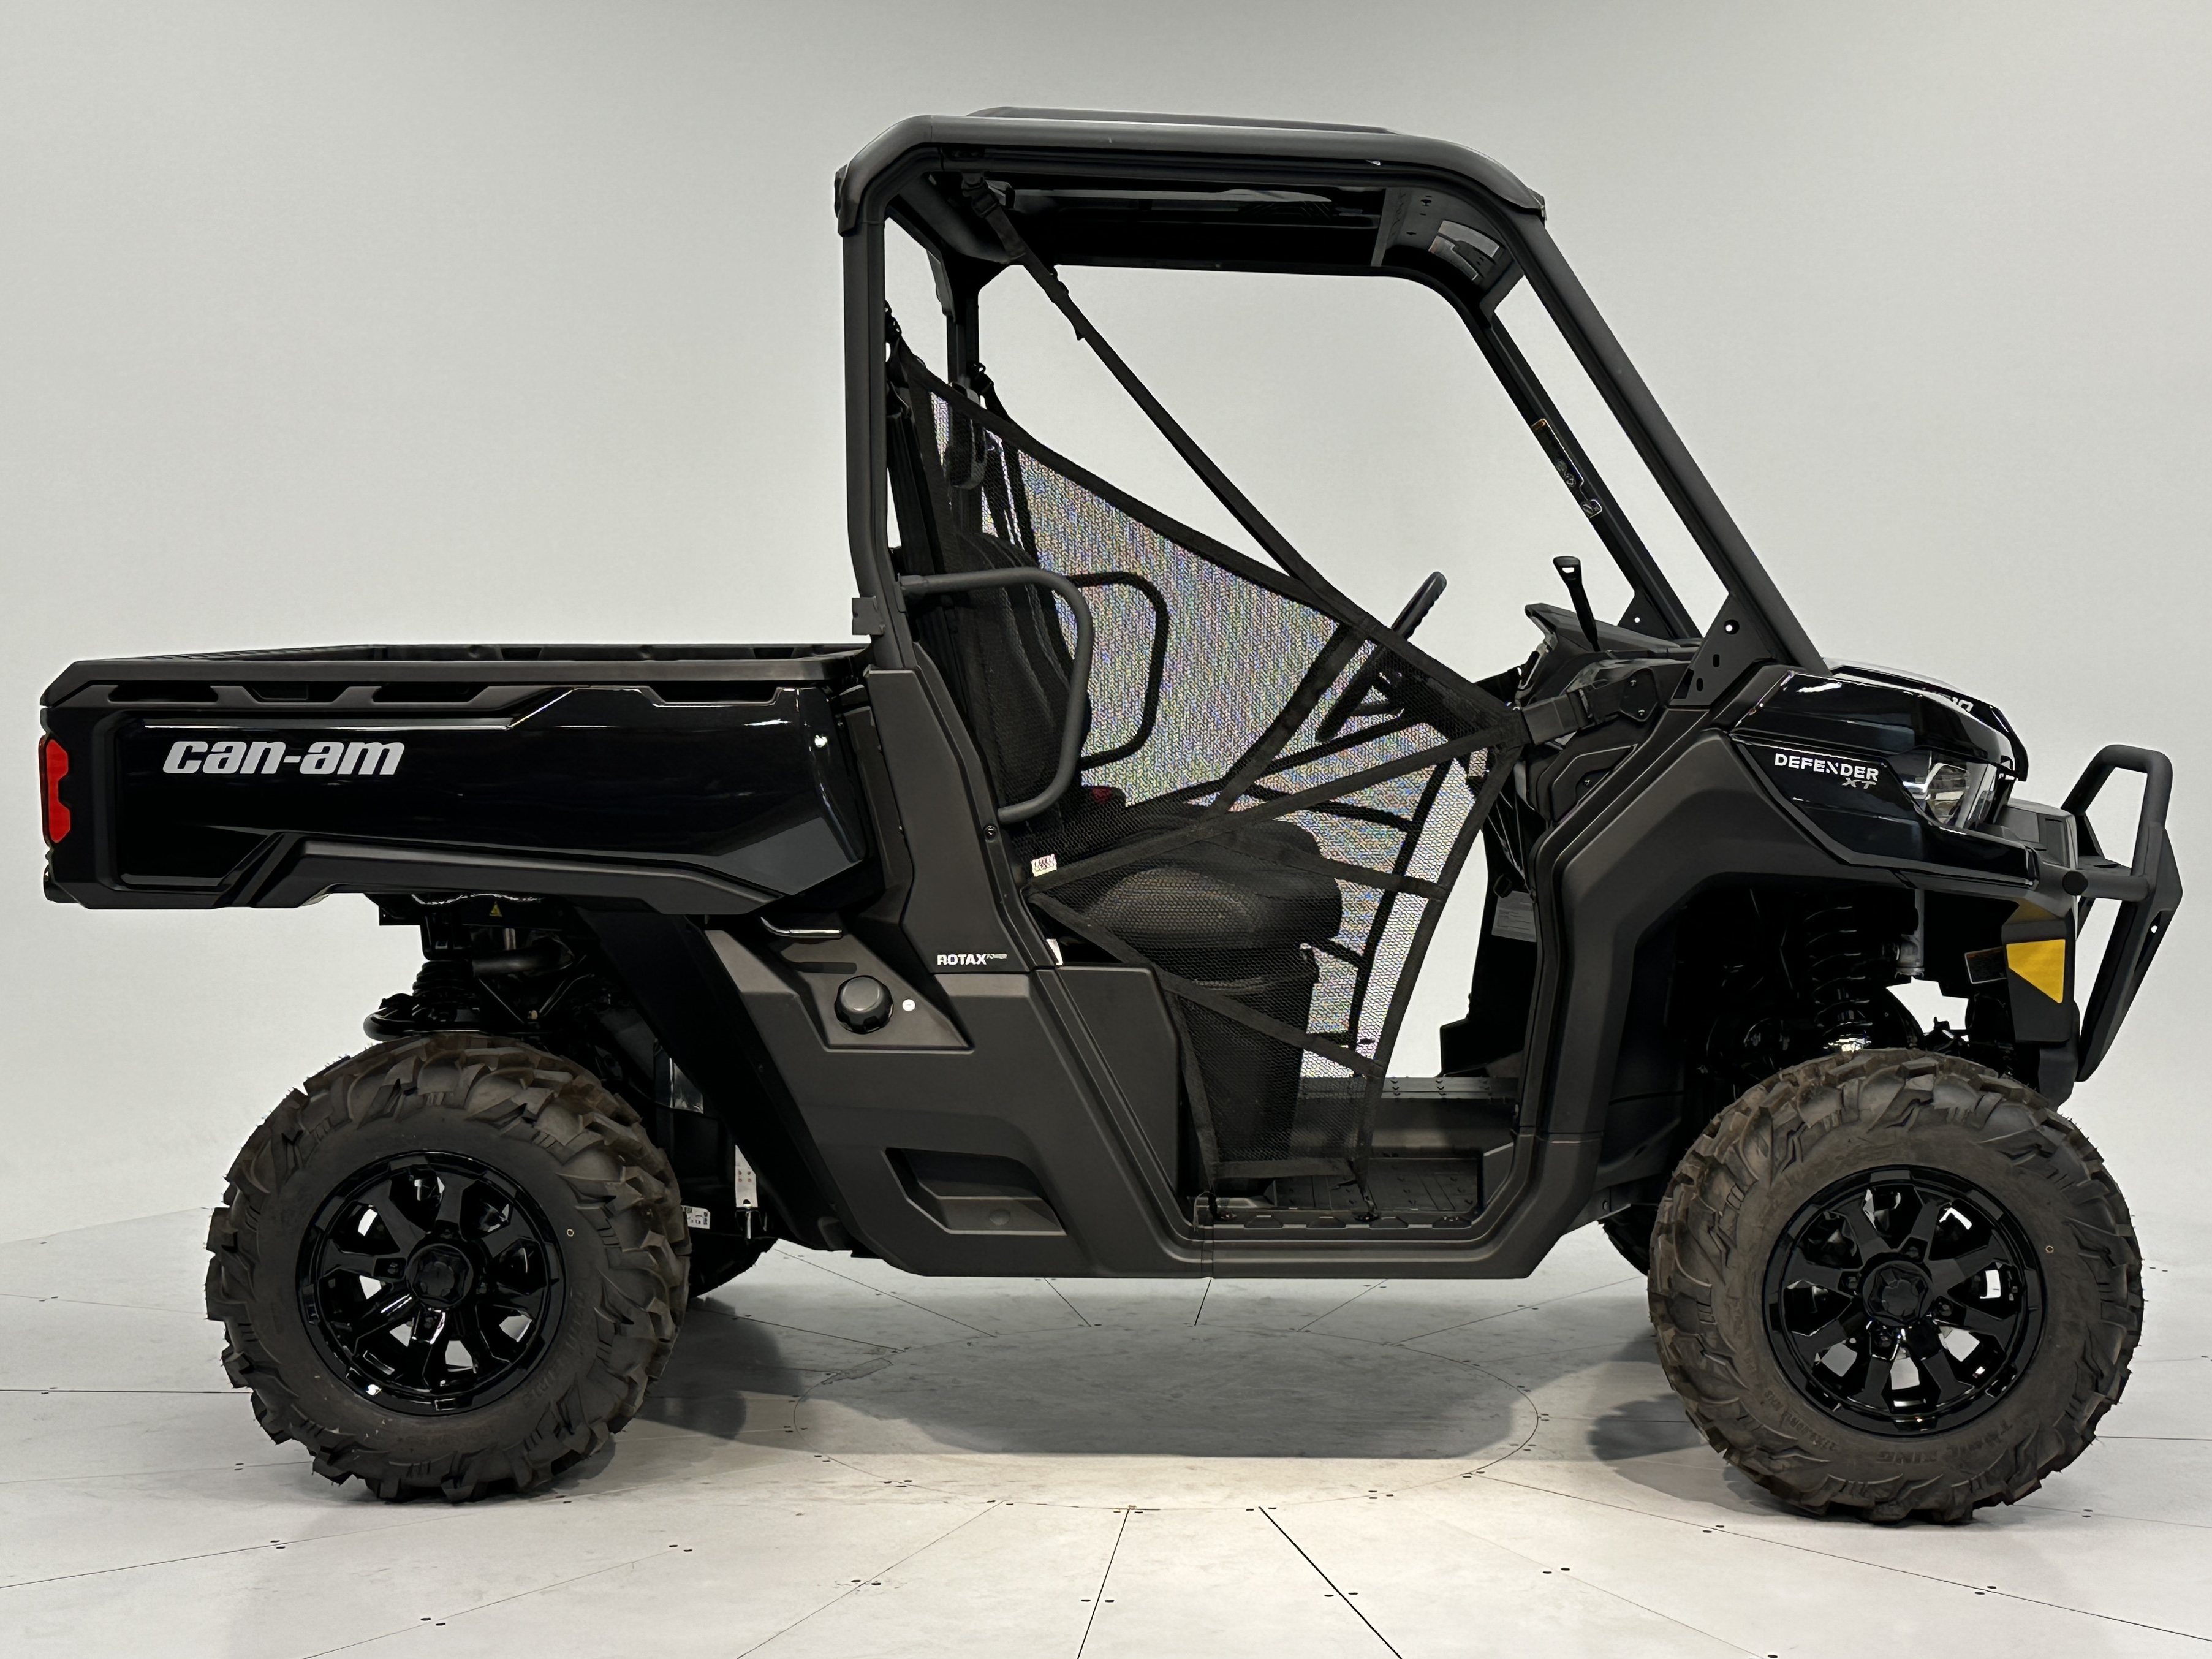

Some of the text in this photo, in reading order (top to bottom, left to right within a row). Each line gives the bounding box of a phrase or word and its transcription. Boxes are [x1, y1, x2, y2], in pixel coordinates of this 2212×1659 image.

[162, 740, 405, 775] can-am
[1774, 753, 1879, 781] DEFENDER
[1841, 777, 1877, 789] XT
[937, 953, 987, 965] ROTAX
